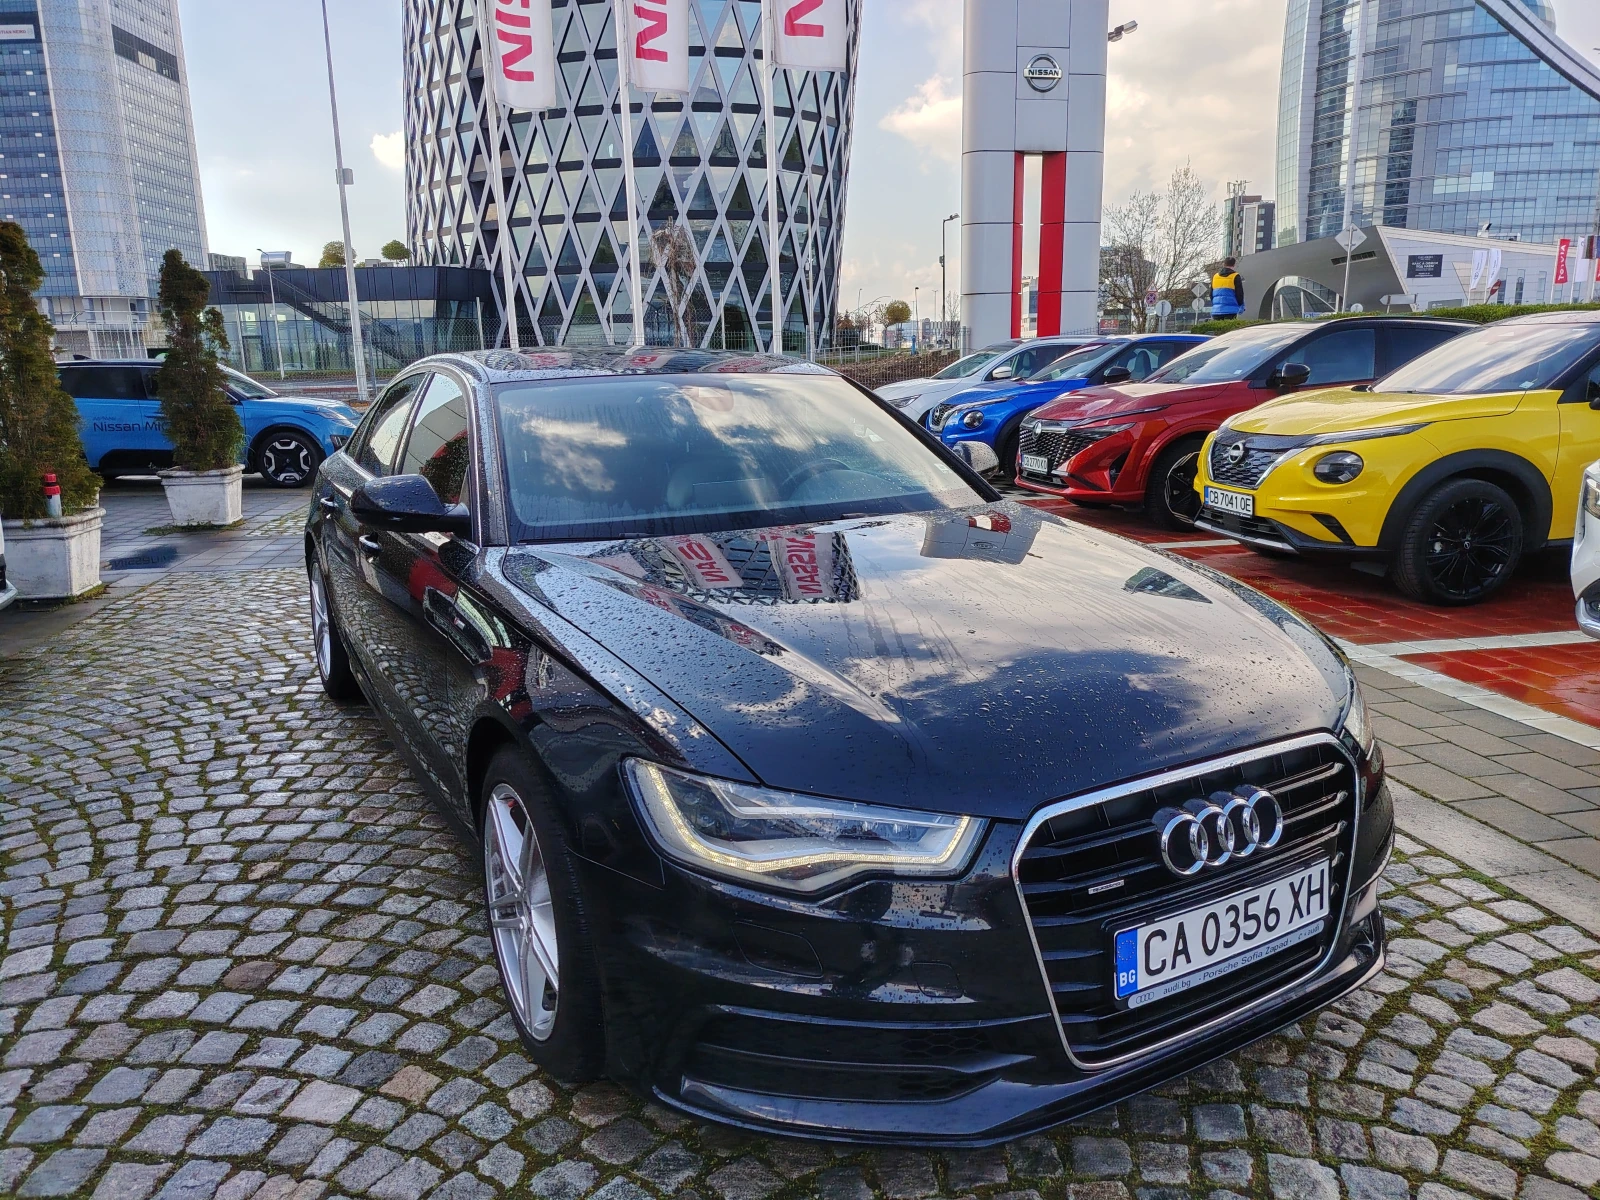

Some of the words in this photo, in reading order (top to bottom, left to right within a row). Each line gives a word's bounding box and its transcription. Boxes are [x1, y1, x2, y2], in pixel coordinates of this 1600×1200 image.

[1028, 69, 1059, 77] NISSAN
[93, 421, 141, 432] Nissan
[1209, 490, 1219, 504] CB
[1220, 493, 1238, 509] 7041
[1240, 497, 1251, 512] OE
[1119, 970, 1136, 987] BG
[1144, 921, 1192, 977] CA
[1201, 888, 1281, 957] 0356
[1288, 868, 1325, 925] XH
[1163, 980, 1191, 995] audi.bg
[1203, 960, 1239, 980] Porsche
[1241, 950, 1263, 965] Sofia
[1265, 938, 1289, 955] Zapad
